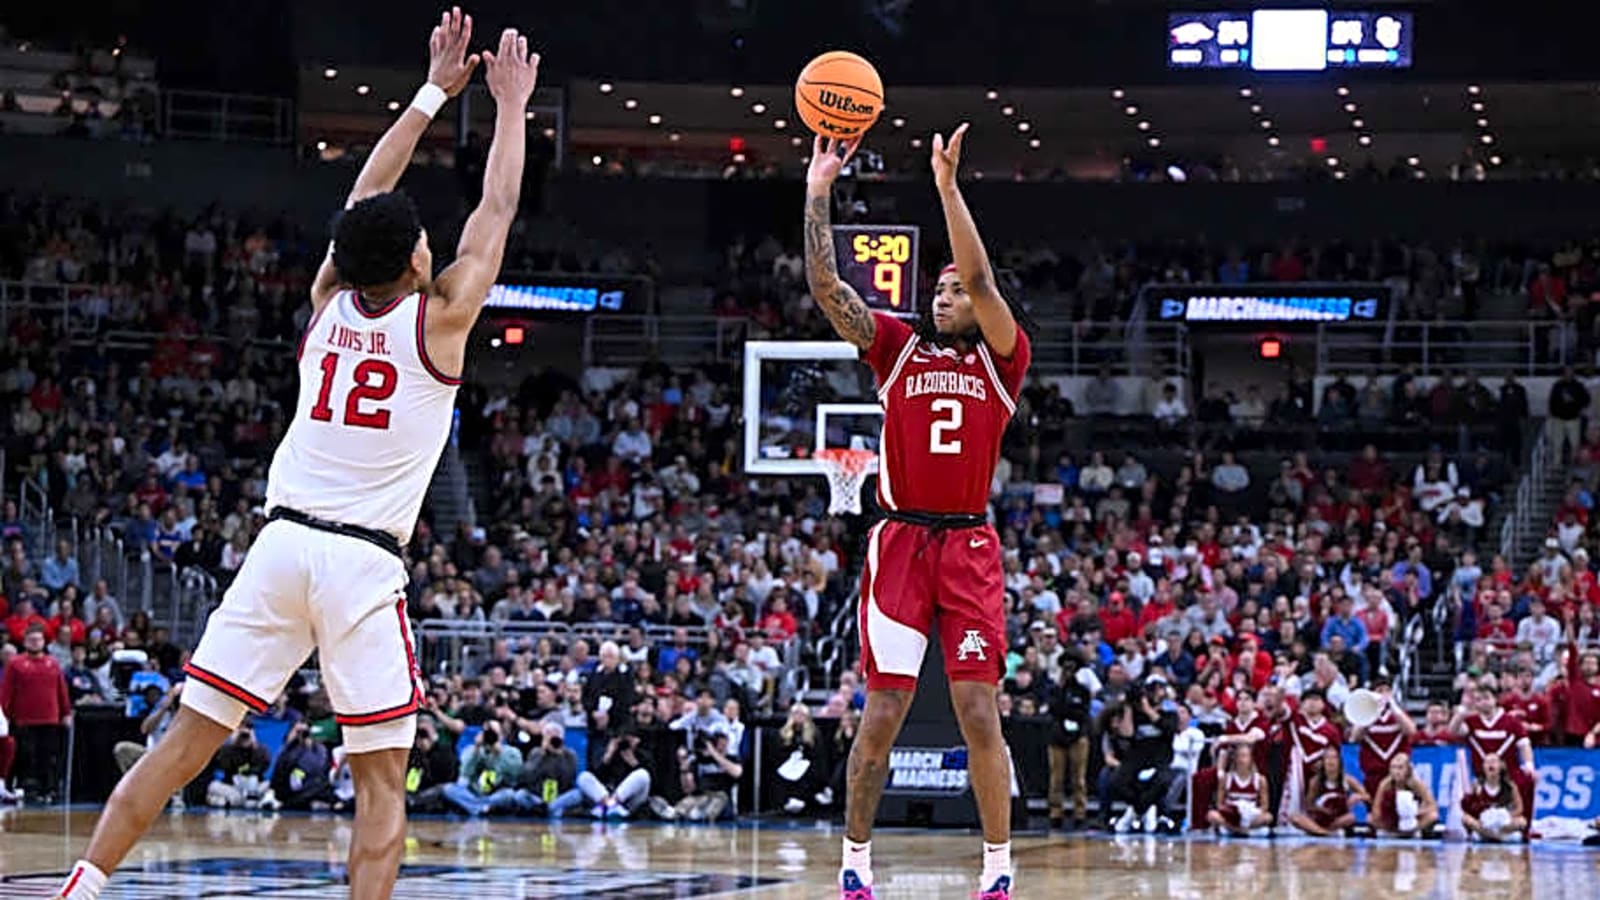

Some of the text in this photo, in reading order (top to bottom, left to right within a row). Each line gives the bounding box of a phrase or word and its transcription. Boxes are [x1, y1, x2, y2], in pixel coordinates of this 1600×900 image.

[819, 88, 875, 114] Wilson
[853, 234, 909, 263] 5:20
[874, 263, 901, 307] 9
[327, 323, 391, 355] LUIS JR.
[310, 351, 398, 430] 12
[930, 398, 963, 454] 2
[889, 752, 943, 768] MARCH
[892, 769, 968, 787] MADNESS
